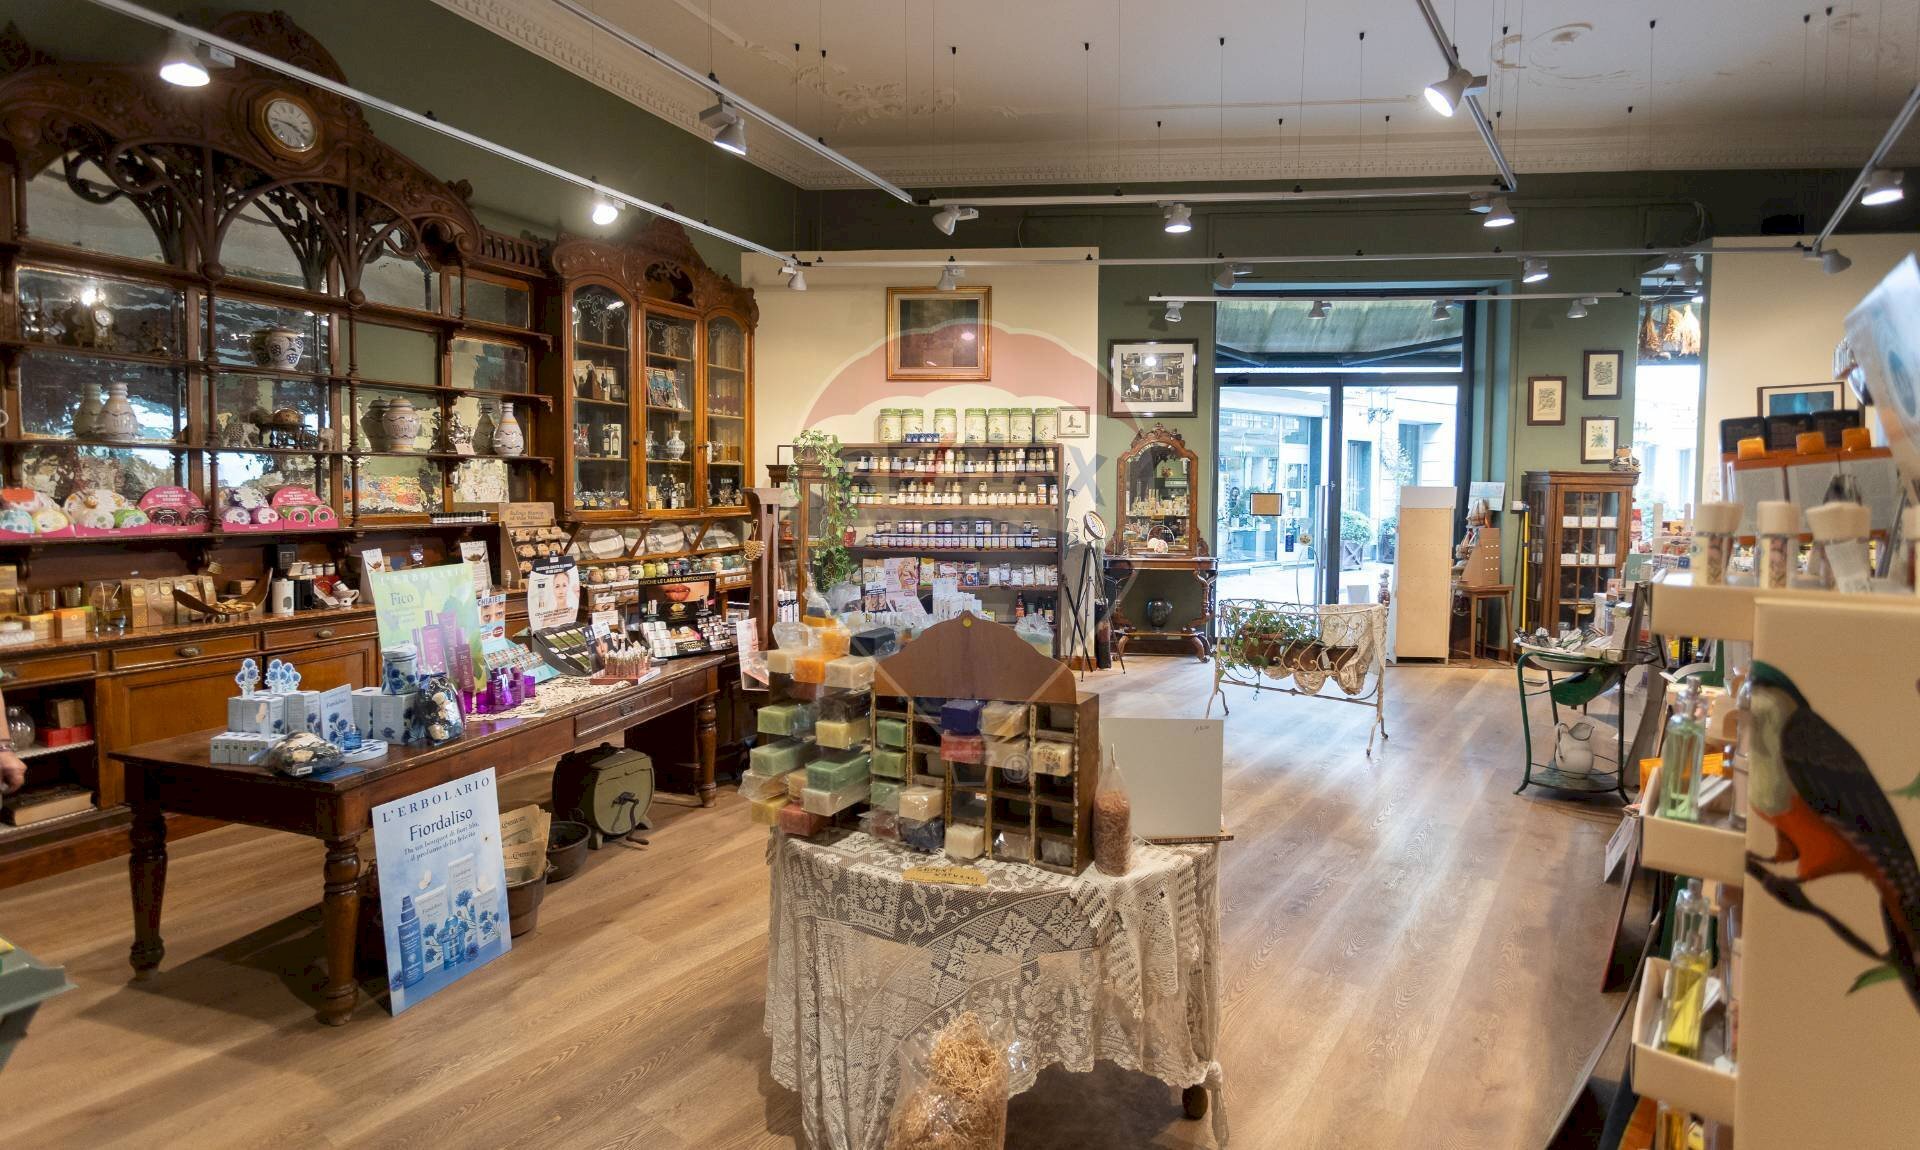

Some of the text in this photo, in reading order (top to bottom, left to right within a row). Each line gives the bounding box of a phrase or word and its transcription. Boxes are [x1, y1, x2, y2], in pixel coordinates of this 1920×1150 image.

[390, 591, 414, 607] Fico
[382, 776, 490, 823] L'ERBOLARIO
[409, 808, 473, 842] Fiordaliso
